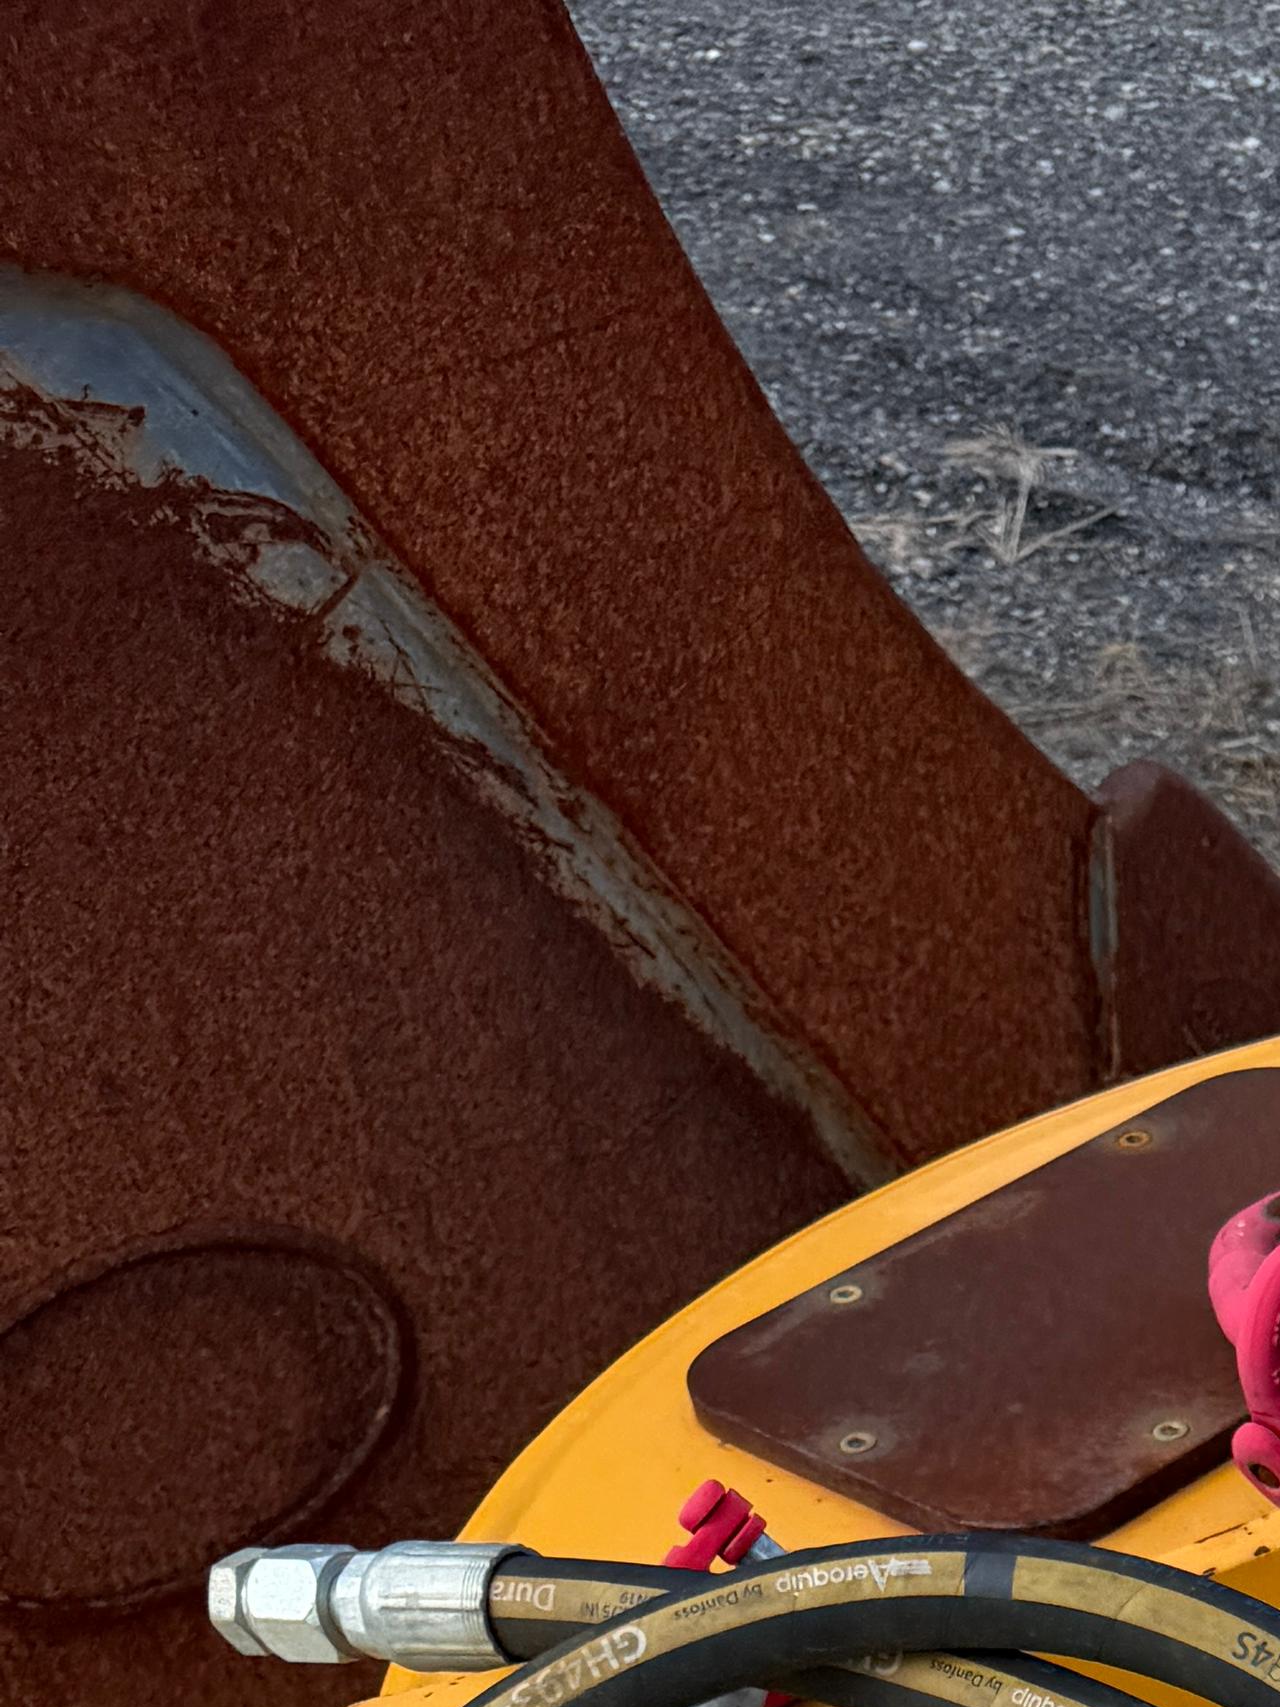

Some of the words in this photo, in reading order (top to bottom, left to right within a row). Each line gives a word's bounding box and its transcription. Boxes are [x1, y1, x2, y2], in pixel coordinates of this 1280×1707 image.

[742, 1583, 764, 1599] by
[776, 1556, 932, 1597] Aeroquip
[490, 1580, 557, 1611] Dura
[673, 1591, 740, 1622] Danfoss
[1232, 1632, 1274, 1668] 4S
[929, 1659, 985, 1689] Danfoss
[984, 1675, 1004, 1694] by
